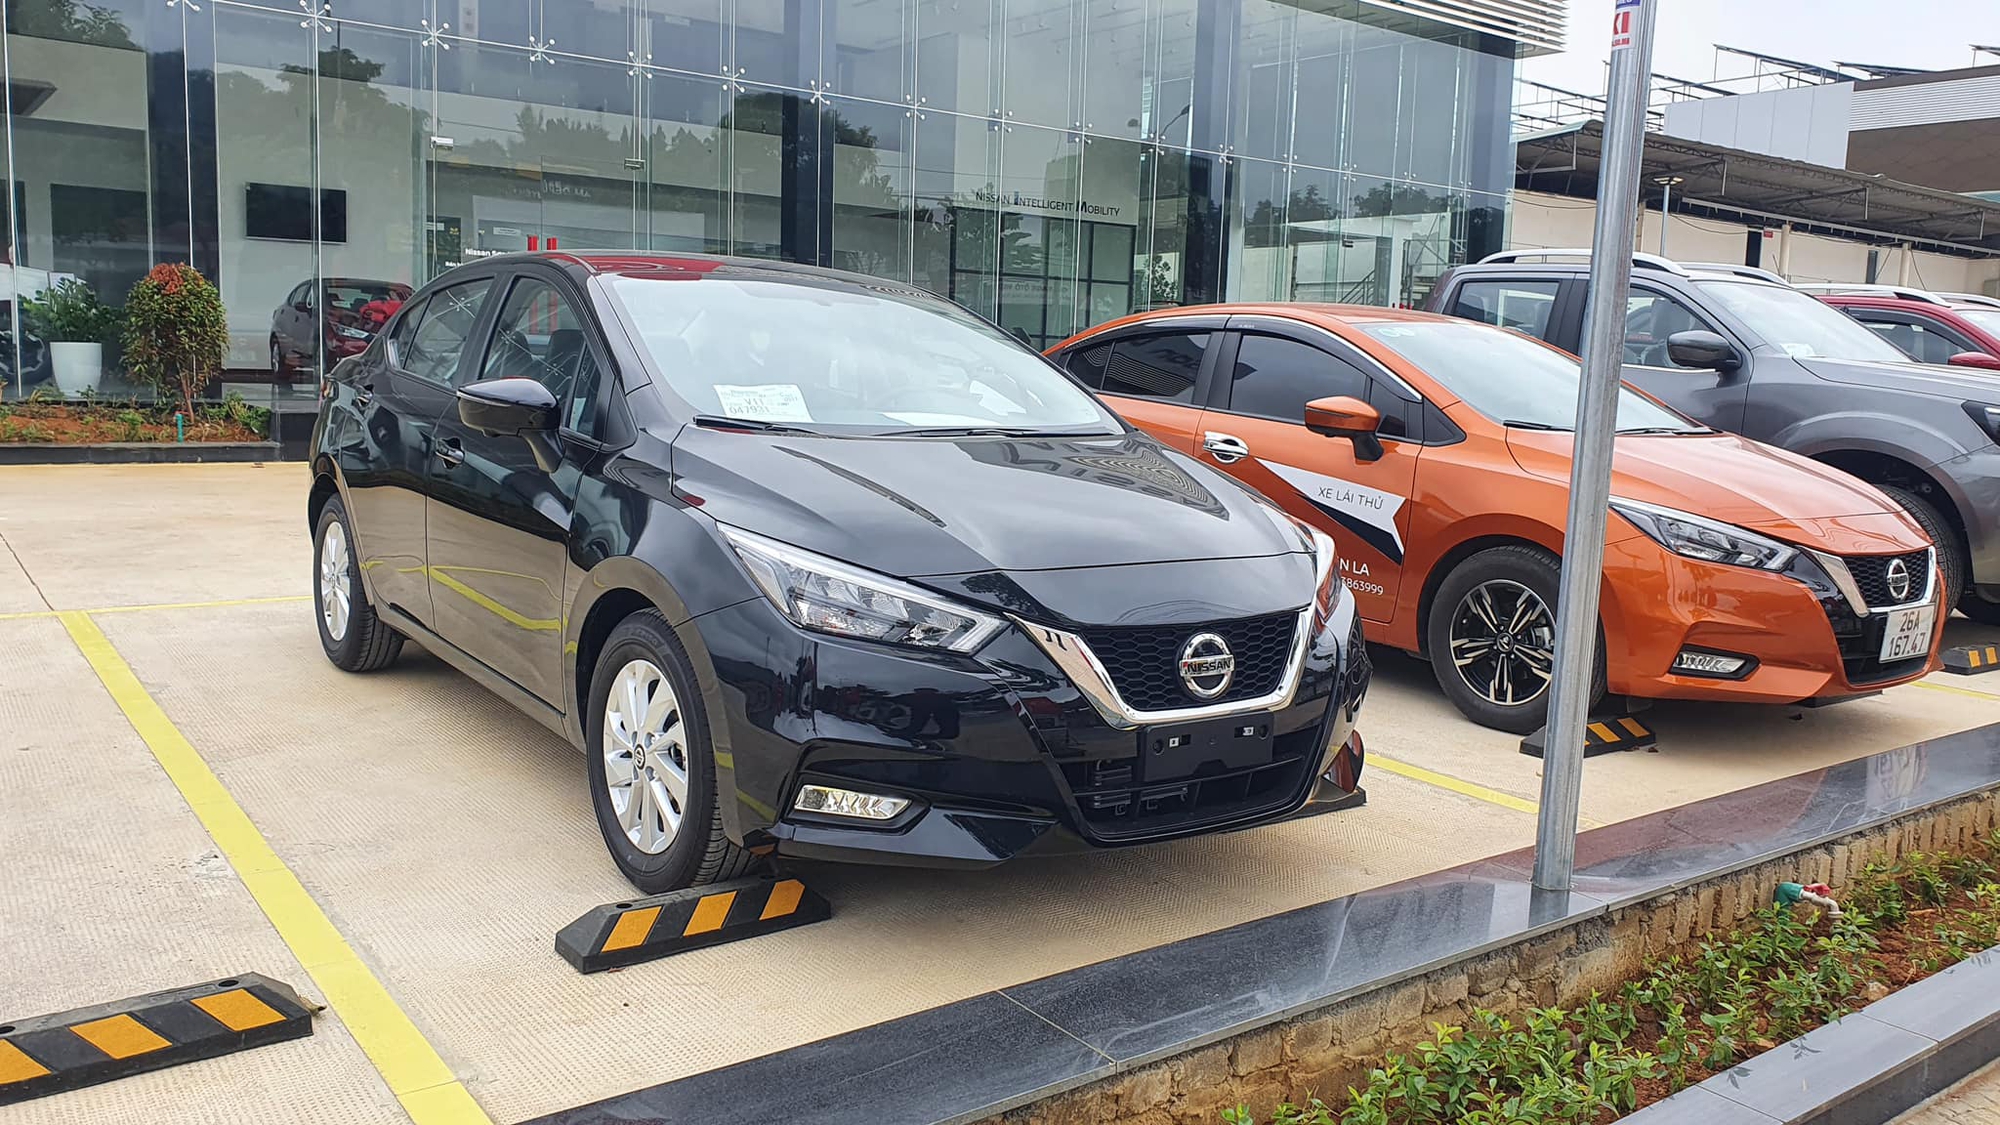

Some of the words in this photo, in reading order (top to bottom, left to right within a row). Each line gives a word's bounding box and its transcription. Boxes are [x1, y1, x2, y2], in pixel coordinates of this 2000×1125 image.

[975, 191, 1011, 205] NISSAN
[1013, 191, 1074, 212] INTELLIGENT
[1076, 201, 1121, 216] MOBILITY
[1318, 487, 1333, 499] XE
[1336, 489, 1354, 504] LÁI
[1353, 561, 1370, 577] LA
[1900, 610, 1920, 632] 26A
[1888, 633, 1925, 657] 167.47
[1187, 659, 1231, 673] NISSAN
